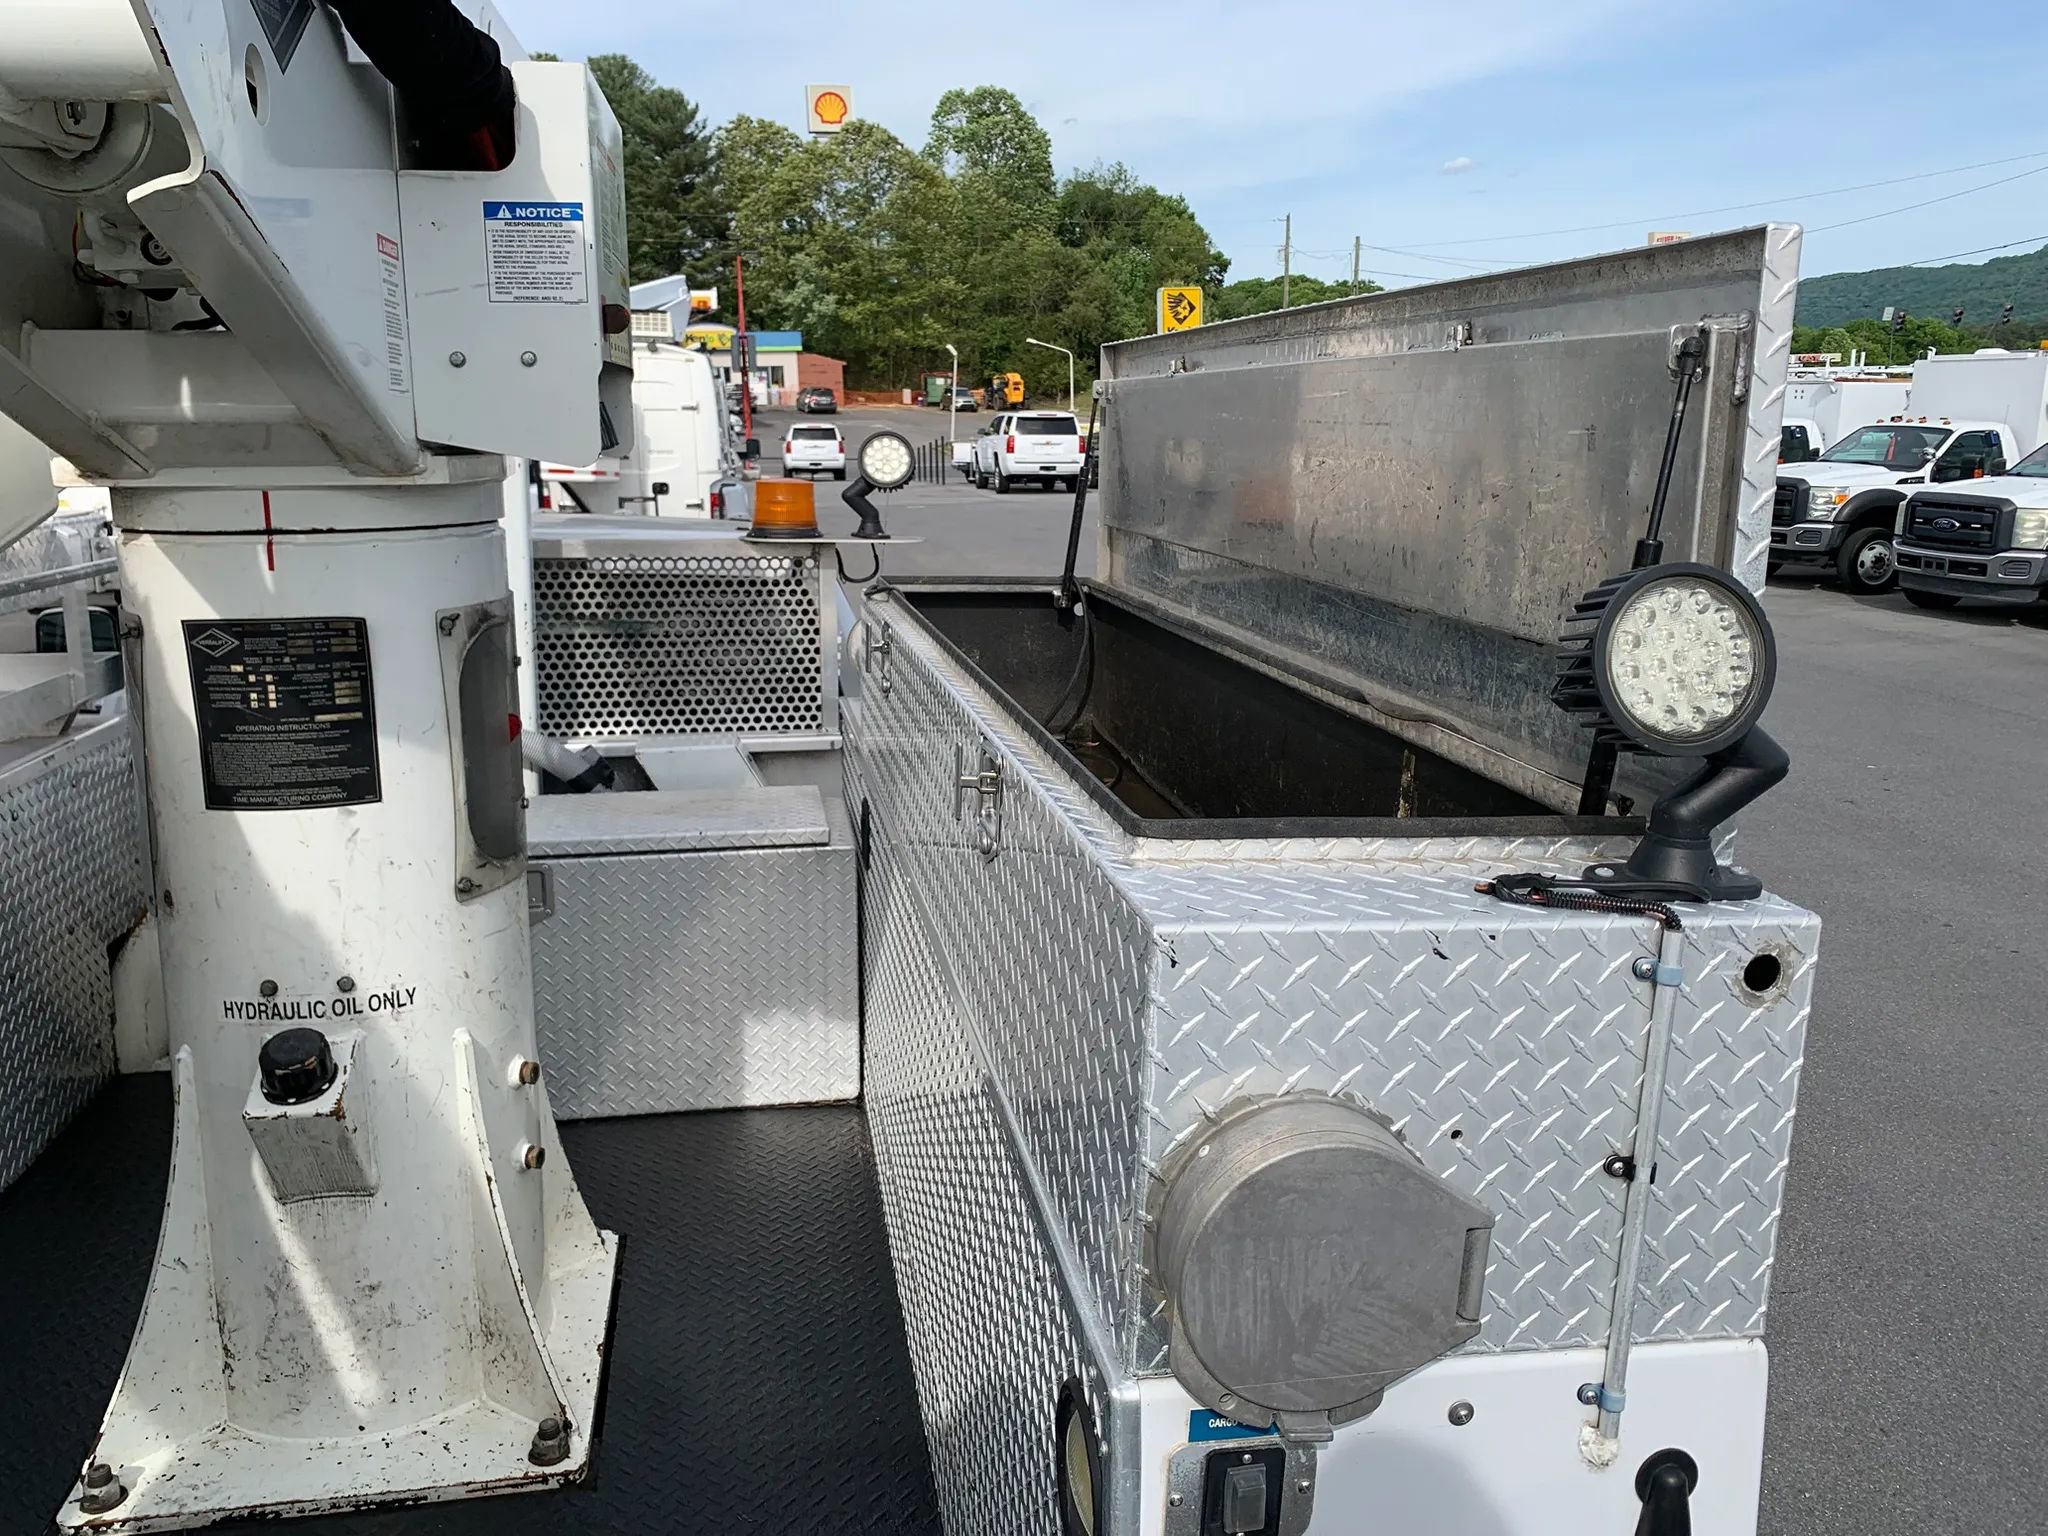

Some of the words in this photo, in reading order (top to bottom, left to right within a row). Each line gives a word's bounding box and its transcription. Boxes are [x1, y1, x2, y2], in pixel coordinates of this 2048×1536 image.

[515, 207, 572, 218] NOTICE
[235, 724, 276, 733] OPERATING
[276, 722, 331, 732] INSTRUCTIONS
[249, 794, 310, 803] MANUFACTURING
[311, 791, 348, 801] COMPANY
[223, 1000, 326, 1021] HYDRAULIC
[331, 996, 364, 1017] OIL
[368, 986, 417, 1012] ONLY
[1208, 1417, 1238, 1428] CARGO
